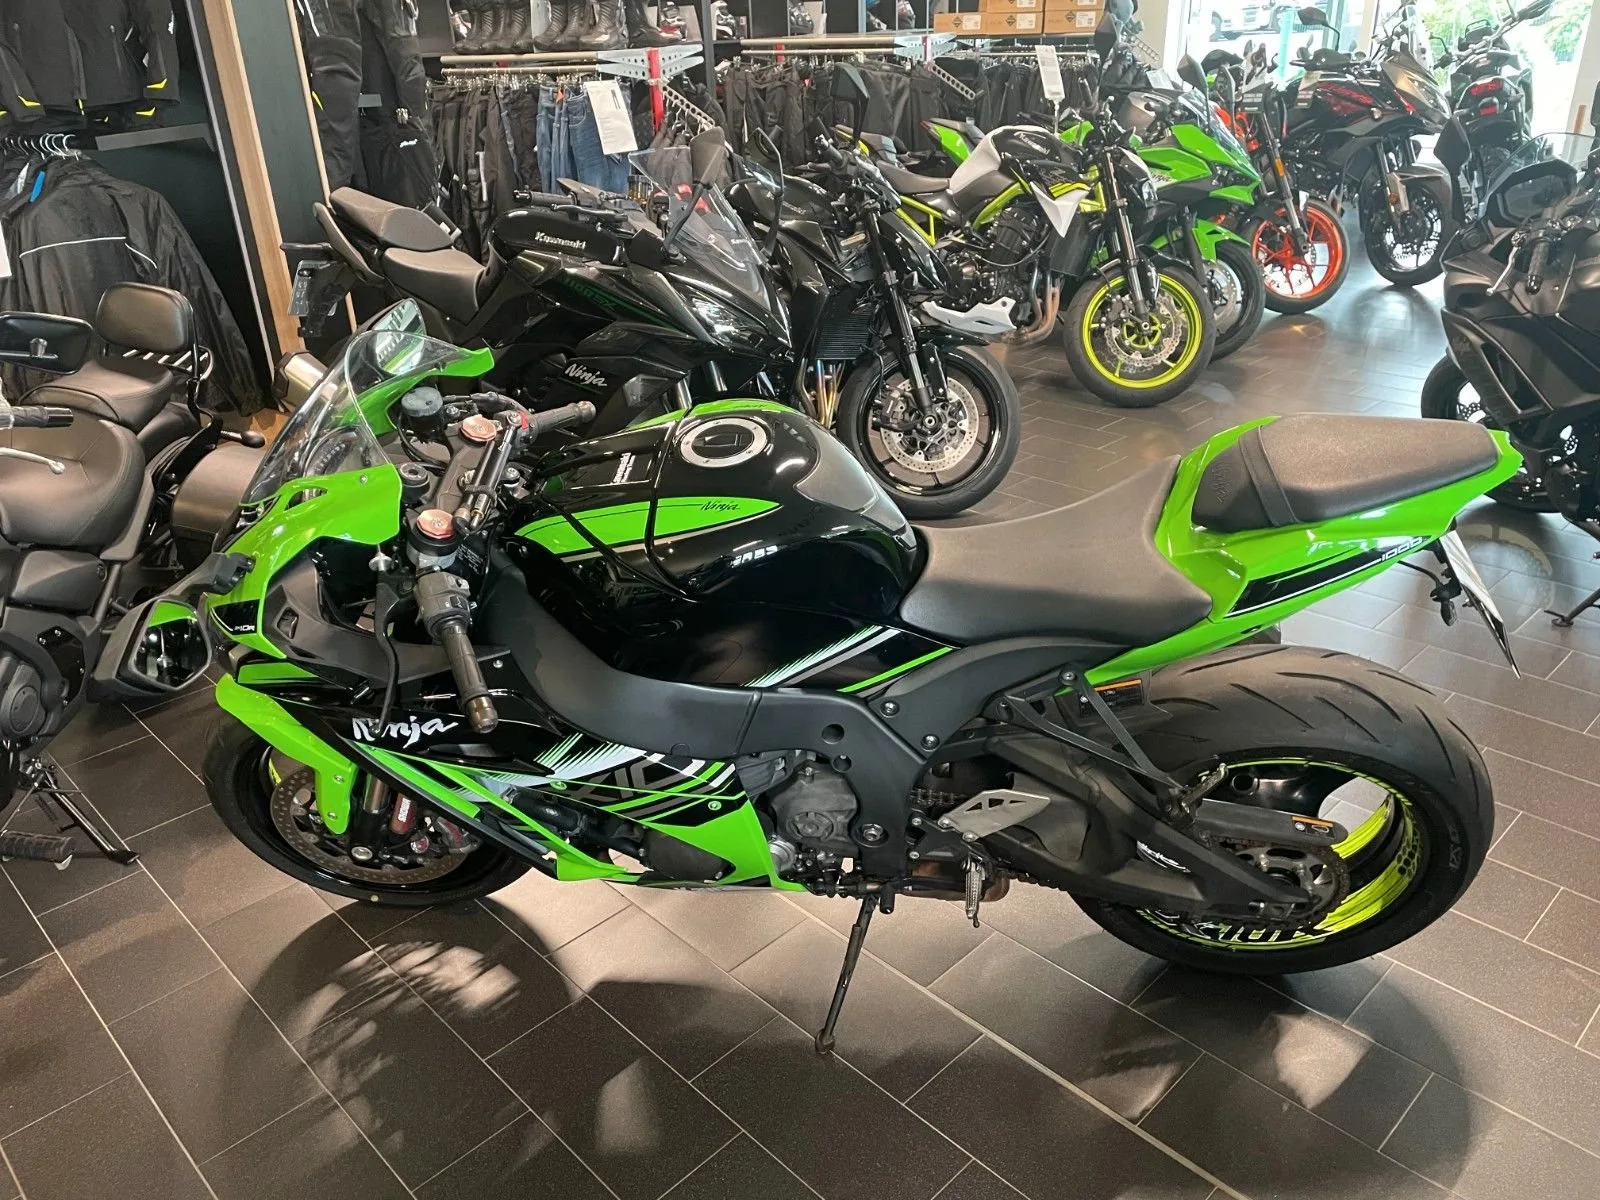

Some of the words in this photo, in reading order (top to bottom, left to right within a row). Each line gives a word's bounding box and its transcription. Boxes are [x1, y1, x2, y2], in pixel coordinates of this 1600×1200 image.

[564, 363, 608, 387] Ninja
[700, 500, 741, 512] Ninja
[352, 715, 459, 749] Nnja
